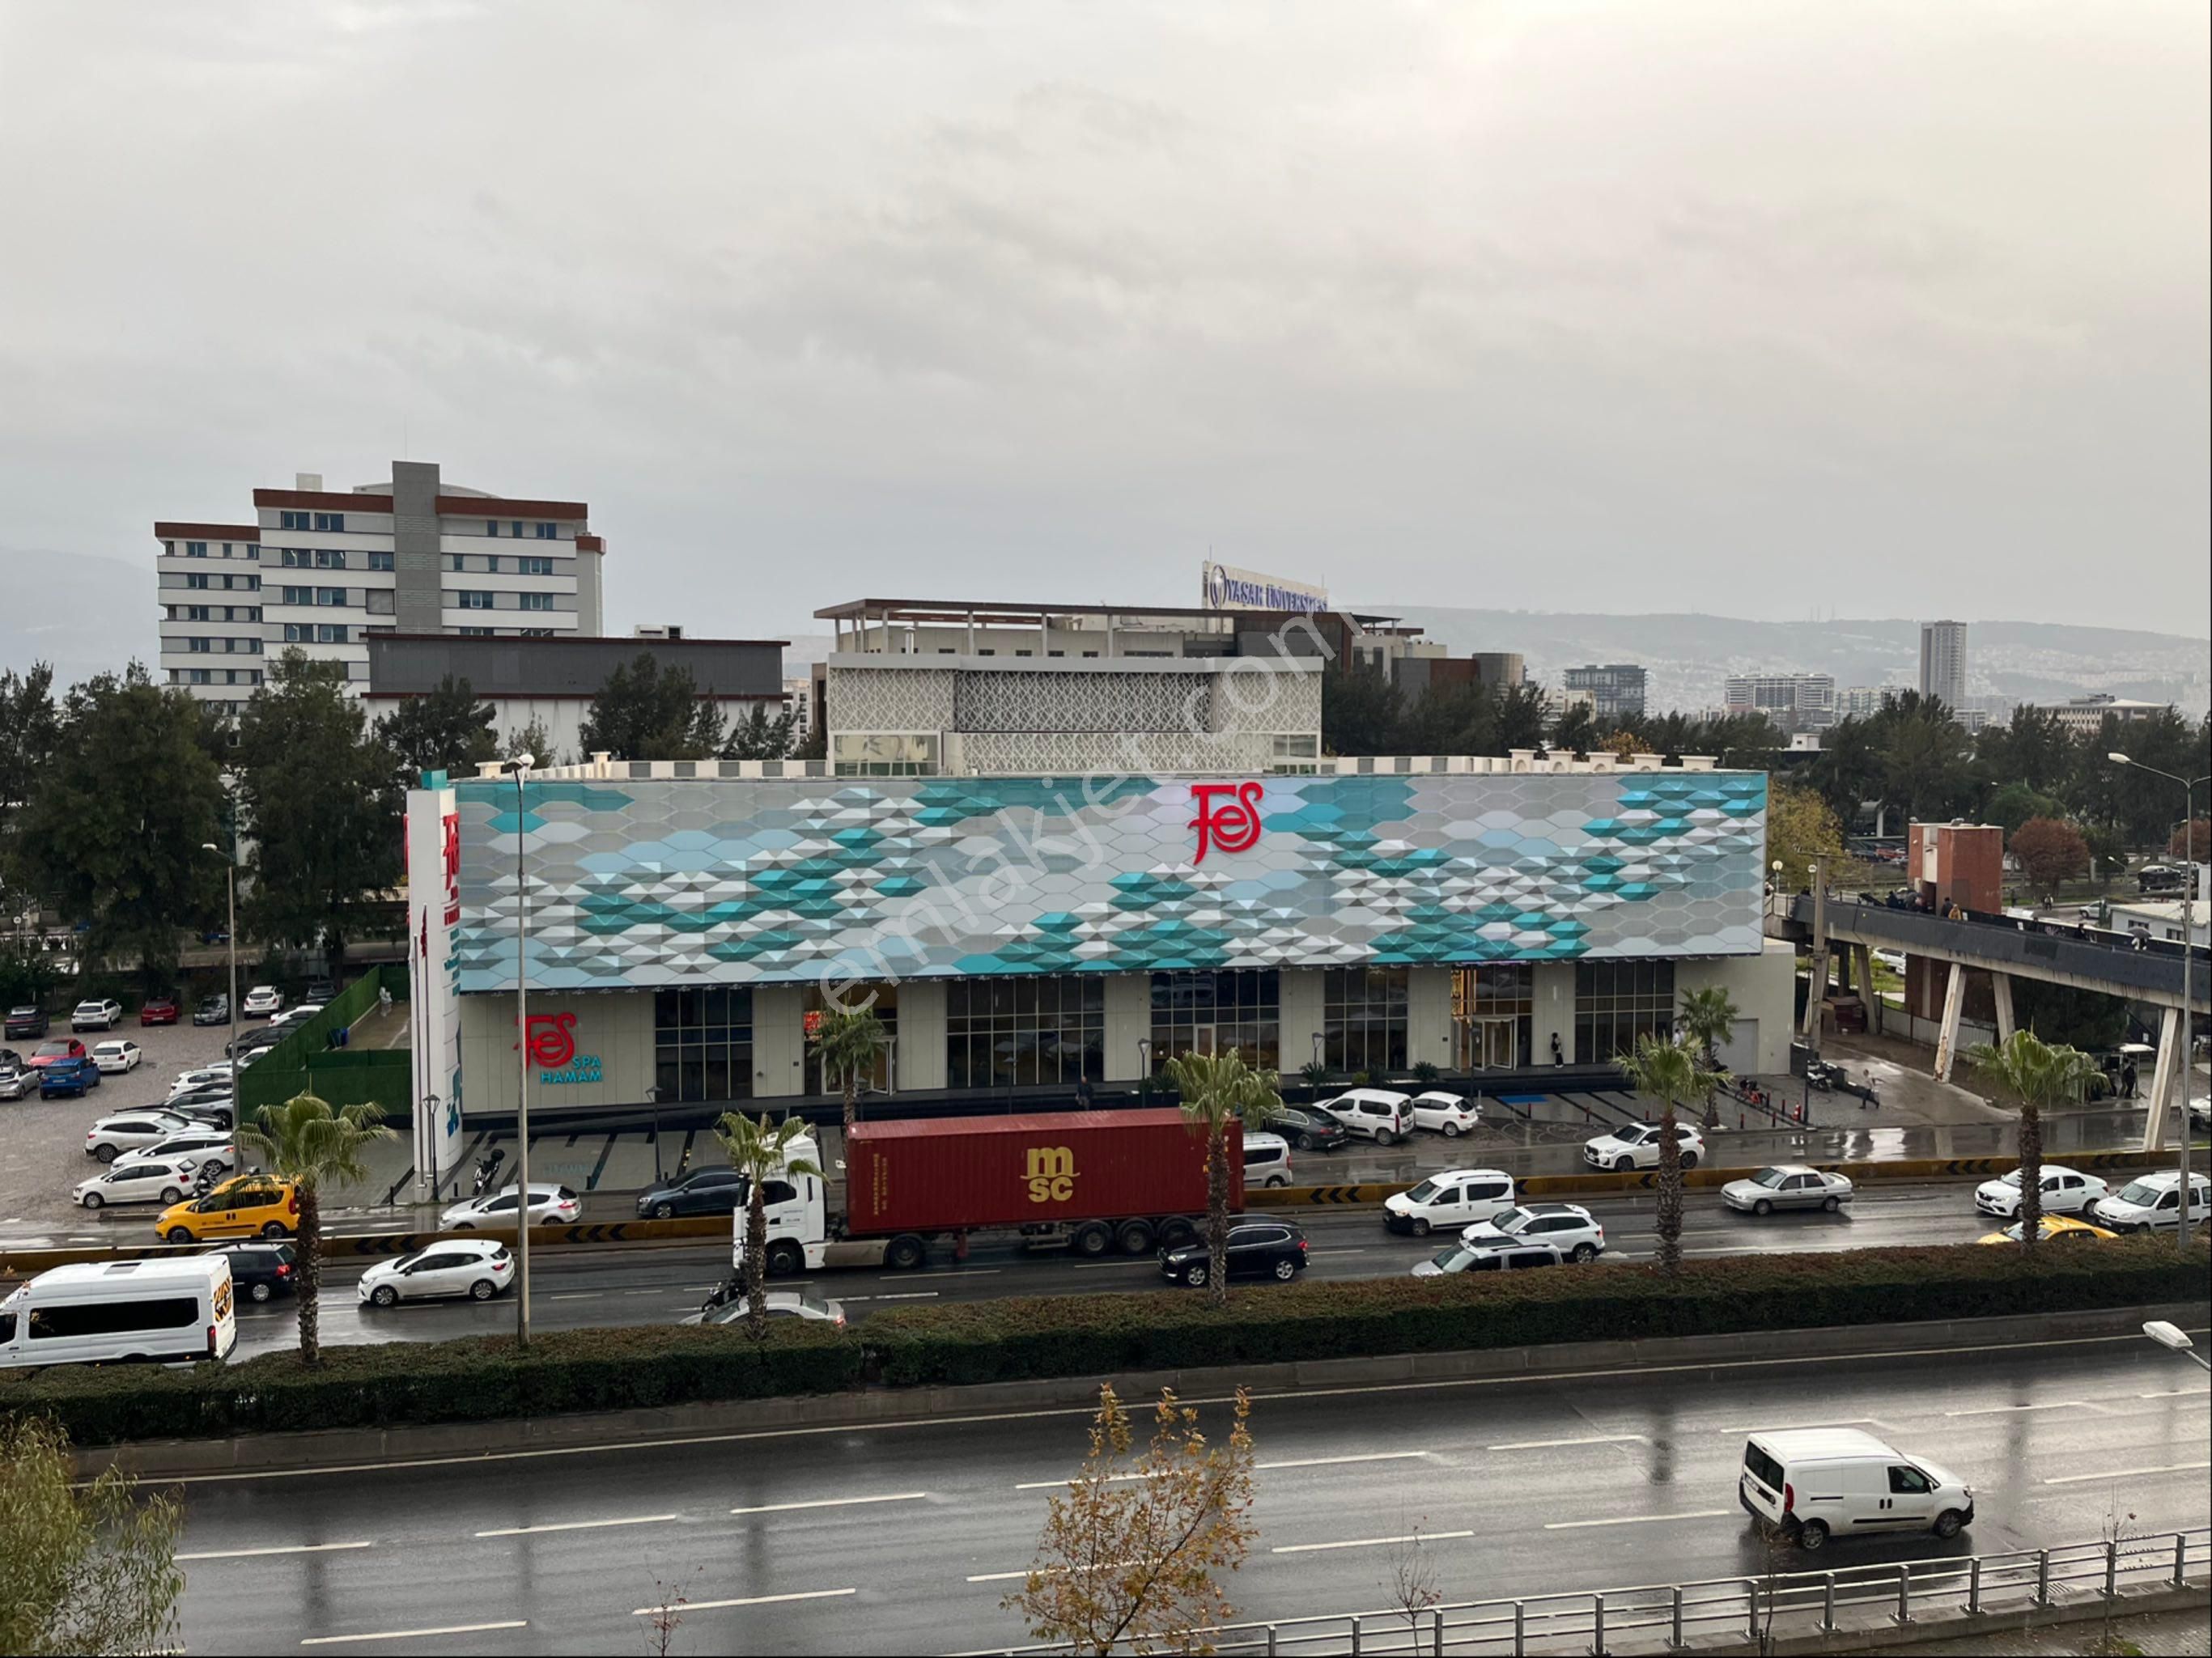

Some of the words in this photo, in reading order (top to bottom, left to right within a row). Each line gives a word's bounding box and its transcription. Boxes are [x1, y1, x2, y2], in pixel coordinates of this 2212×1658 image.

[1225, 578, 1264, 607] YAŞAR
[571, 1055, 602, 1069] SPA
[540, 1070, 603, 1085] HAMAM
